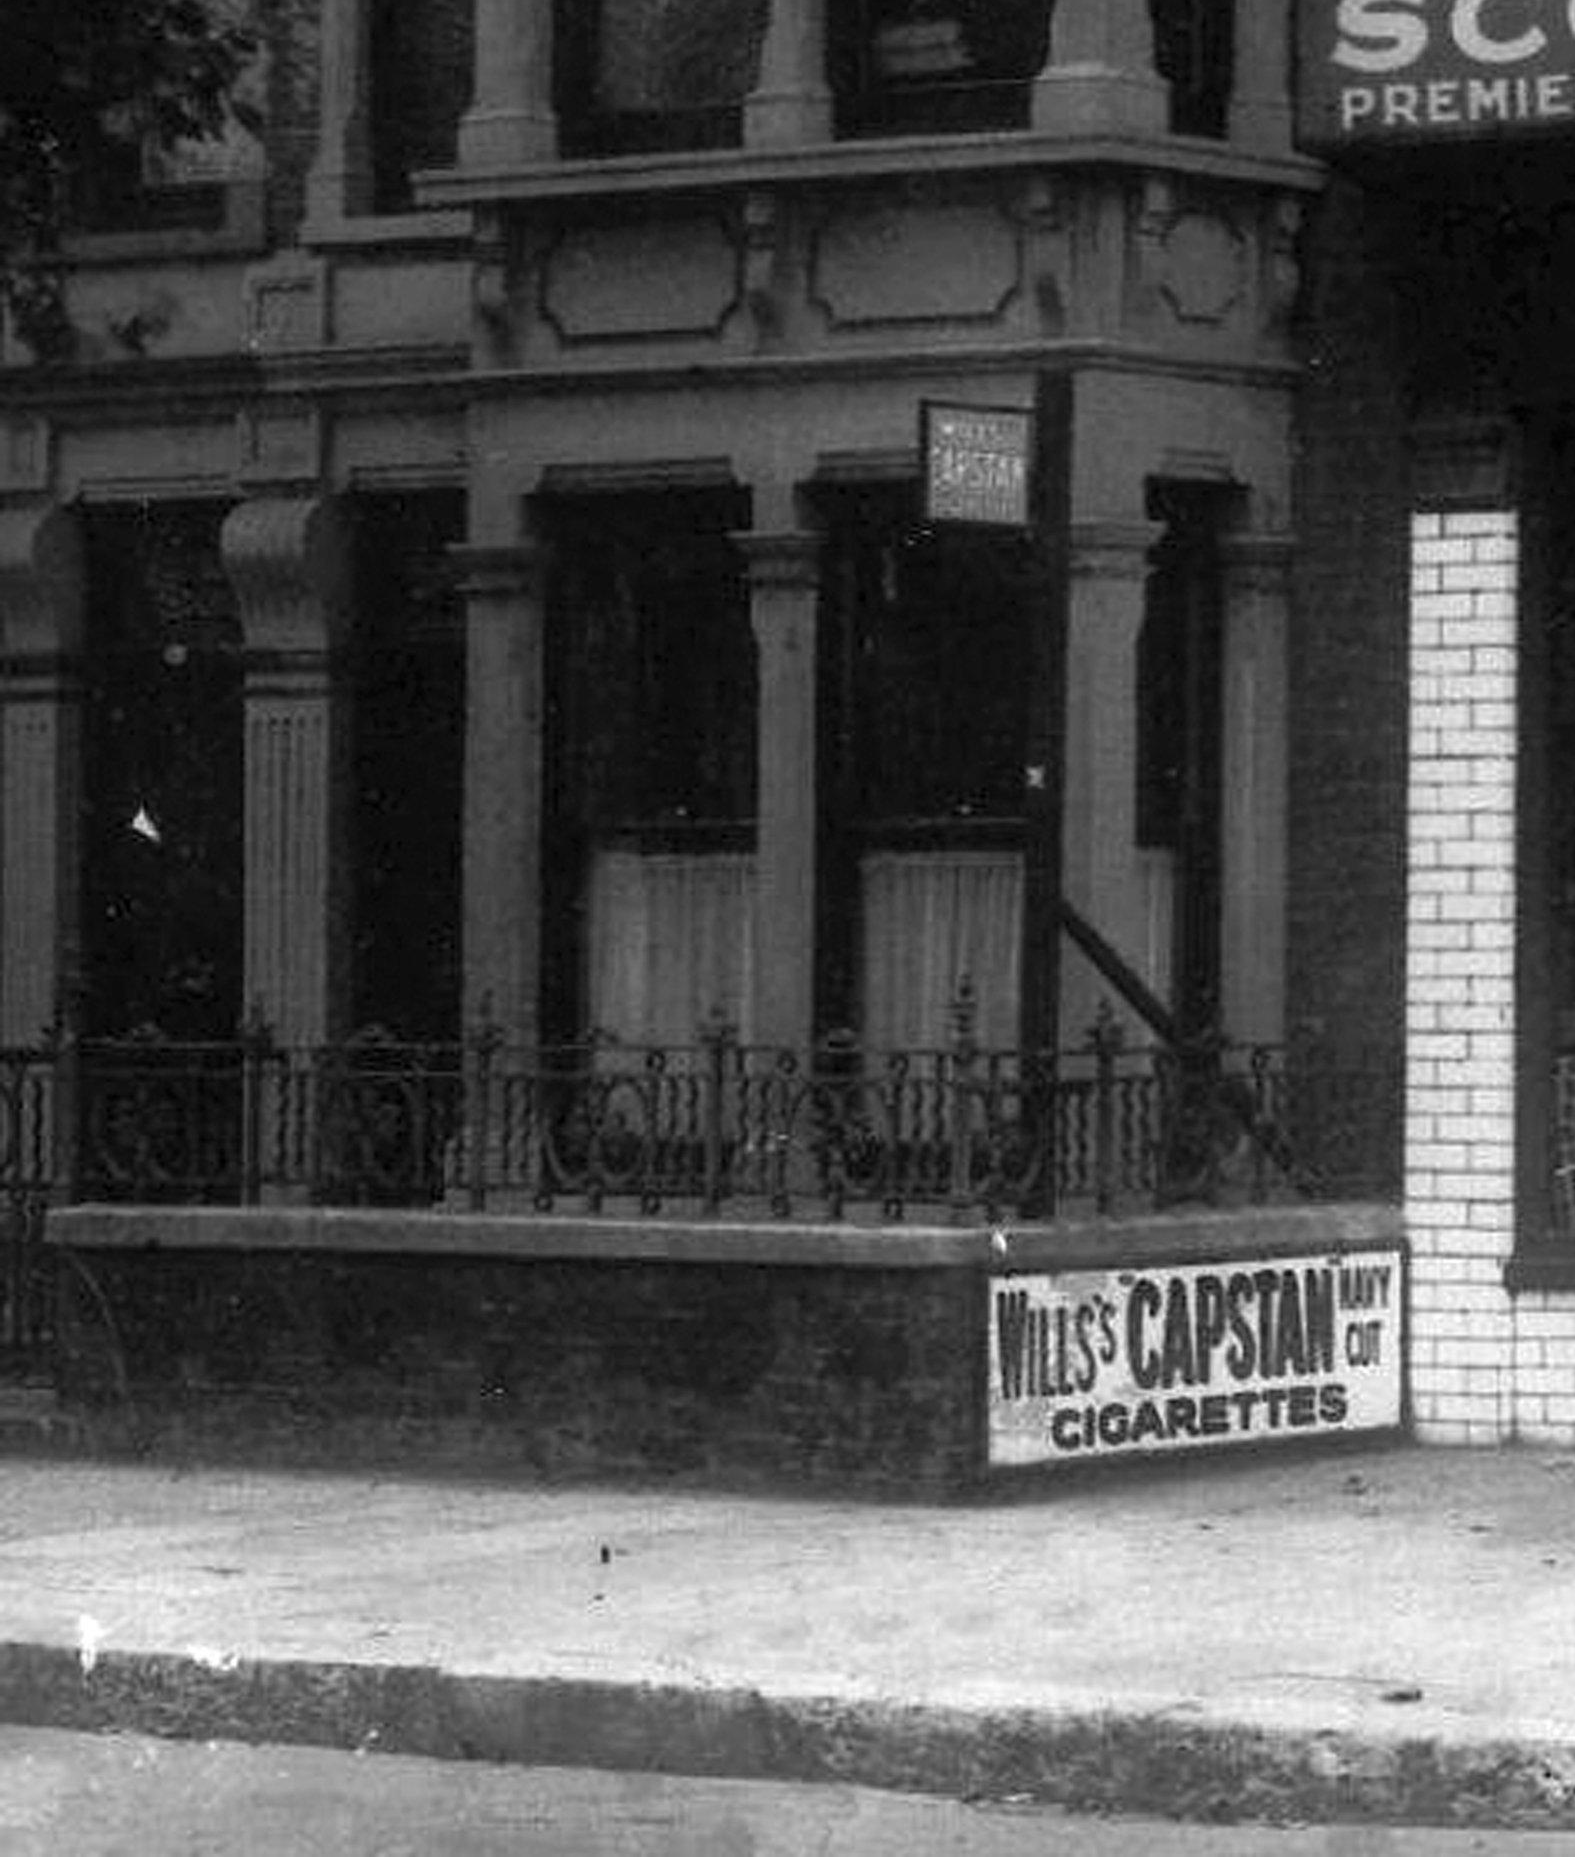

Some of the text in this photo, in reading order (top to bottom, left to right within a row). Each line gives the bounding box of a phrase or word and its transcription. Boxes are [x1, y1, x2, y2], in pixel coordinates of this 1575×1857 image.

[1126, 1268, 1335, 1391] CAPSTAN
[1338, 1265, 1392, 1310] NAVY
[1344, 1319, 1382, 1367] CUT
[1050, 1383, 1349, 1451] CIGARETTES
